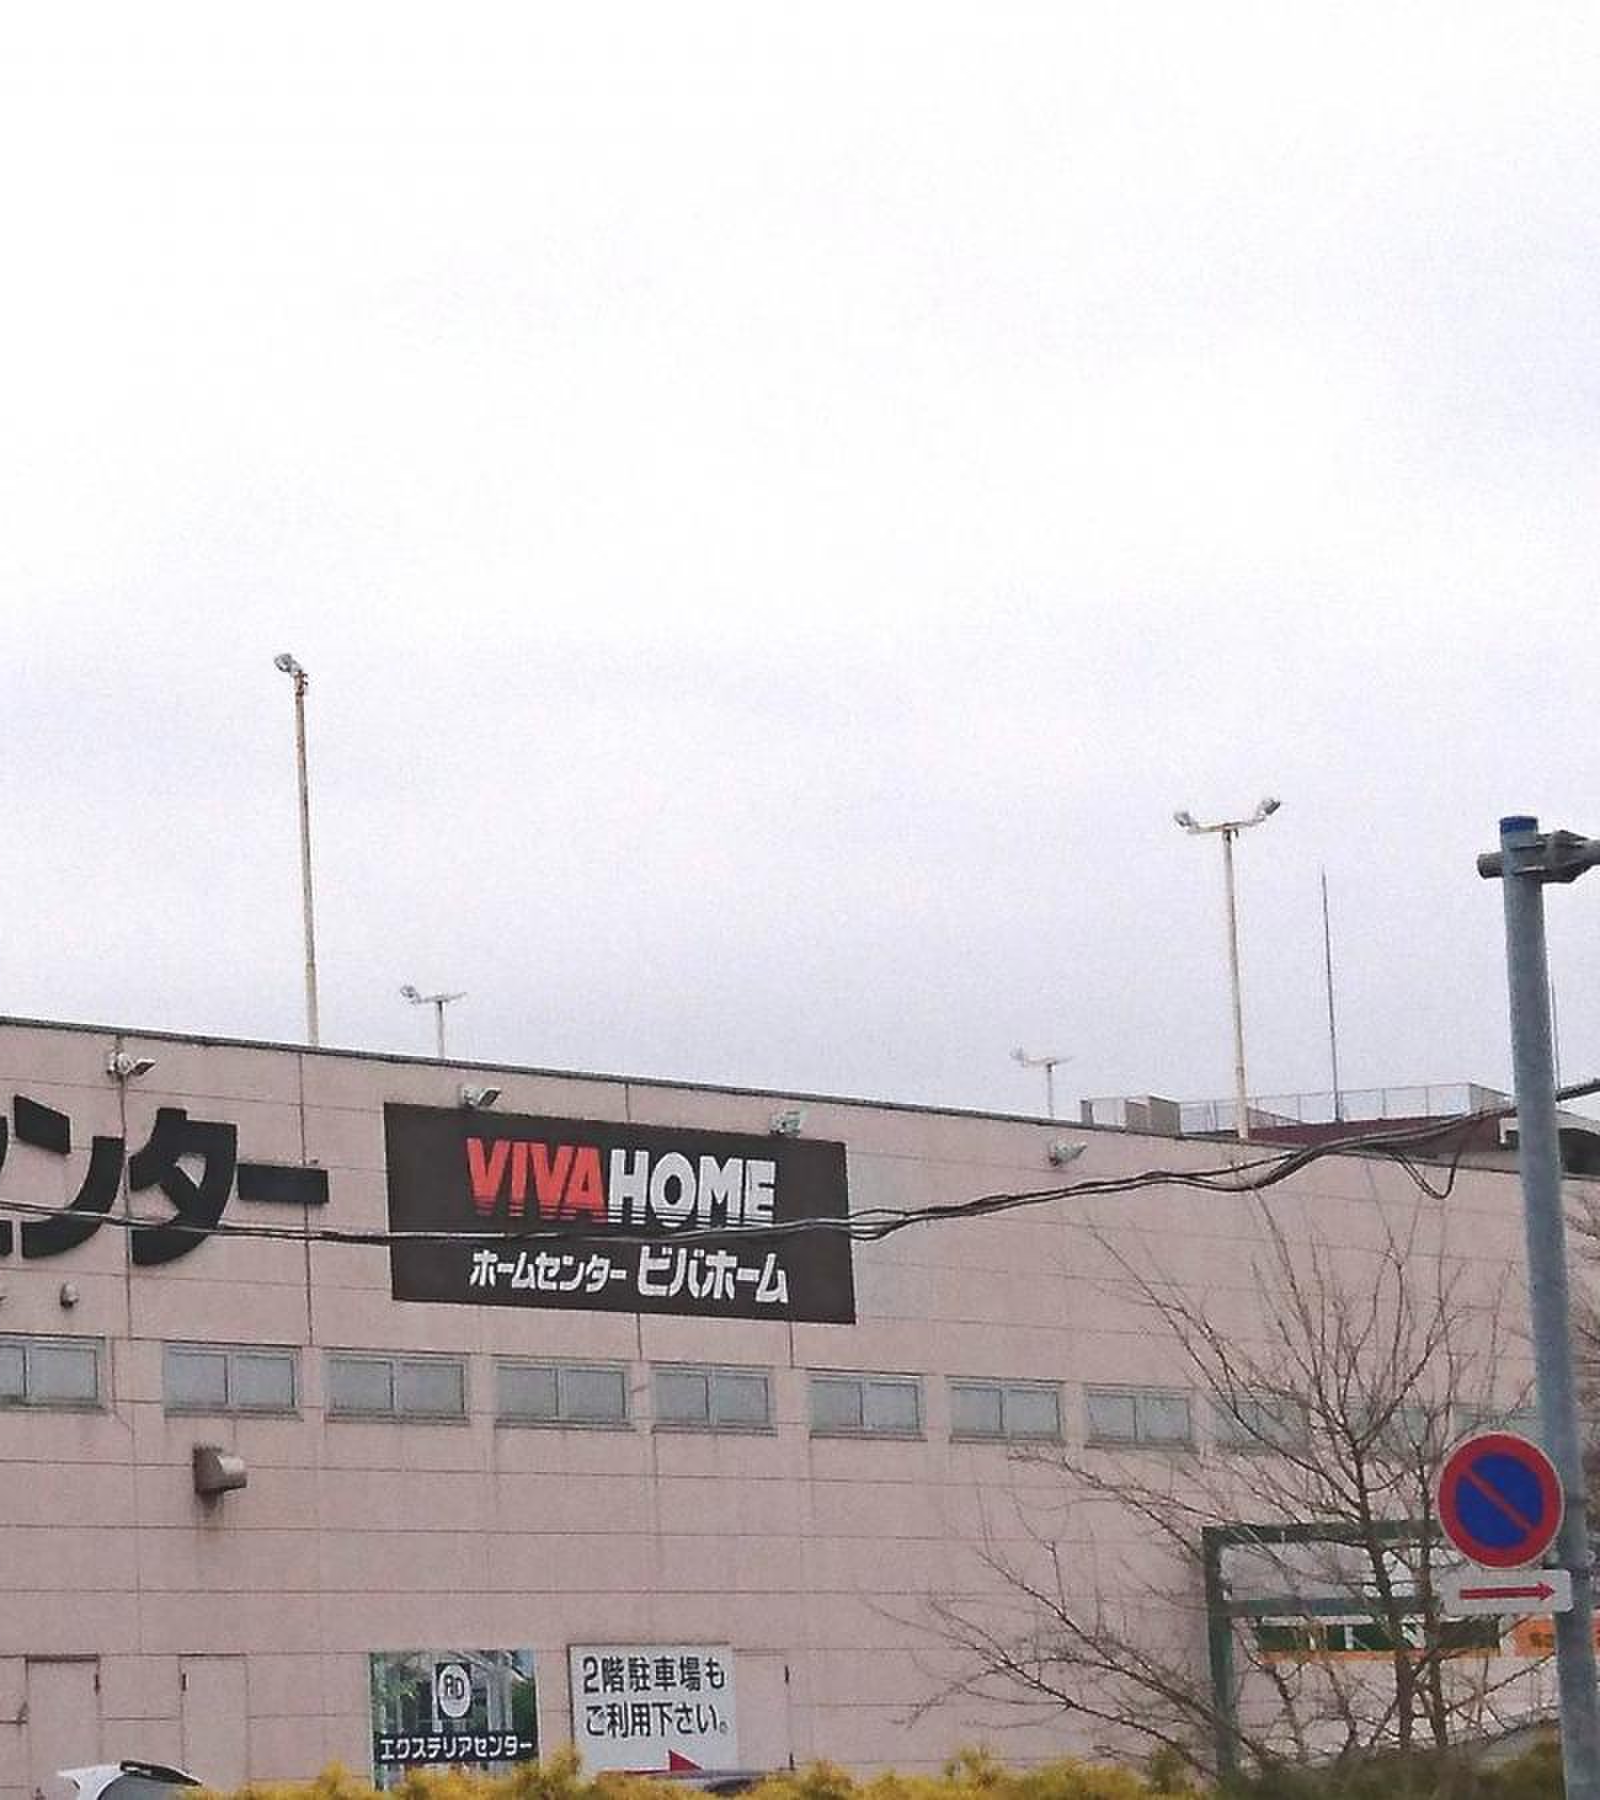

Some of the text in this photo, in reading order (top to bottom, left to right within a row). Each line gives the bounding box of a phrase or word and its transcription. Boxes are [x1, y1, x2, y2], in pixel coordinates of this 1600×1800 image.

[466, 1137, 776, 1229] VIVAHOME
[468, 1246, 789, 1304] ホームセンター ビバホーム
[583, 1655, 726, 1694] 2階駐車場も
[585, 1701, 730, 1739] ご利用下さい。
[380, 1734, 533, 1760] エクステリアセンター
